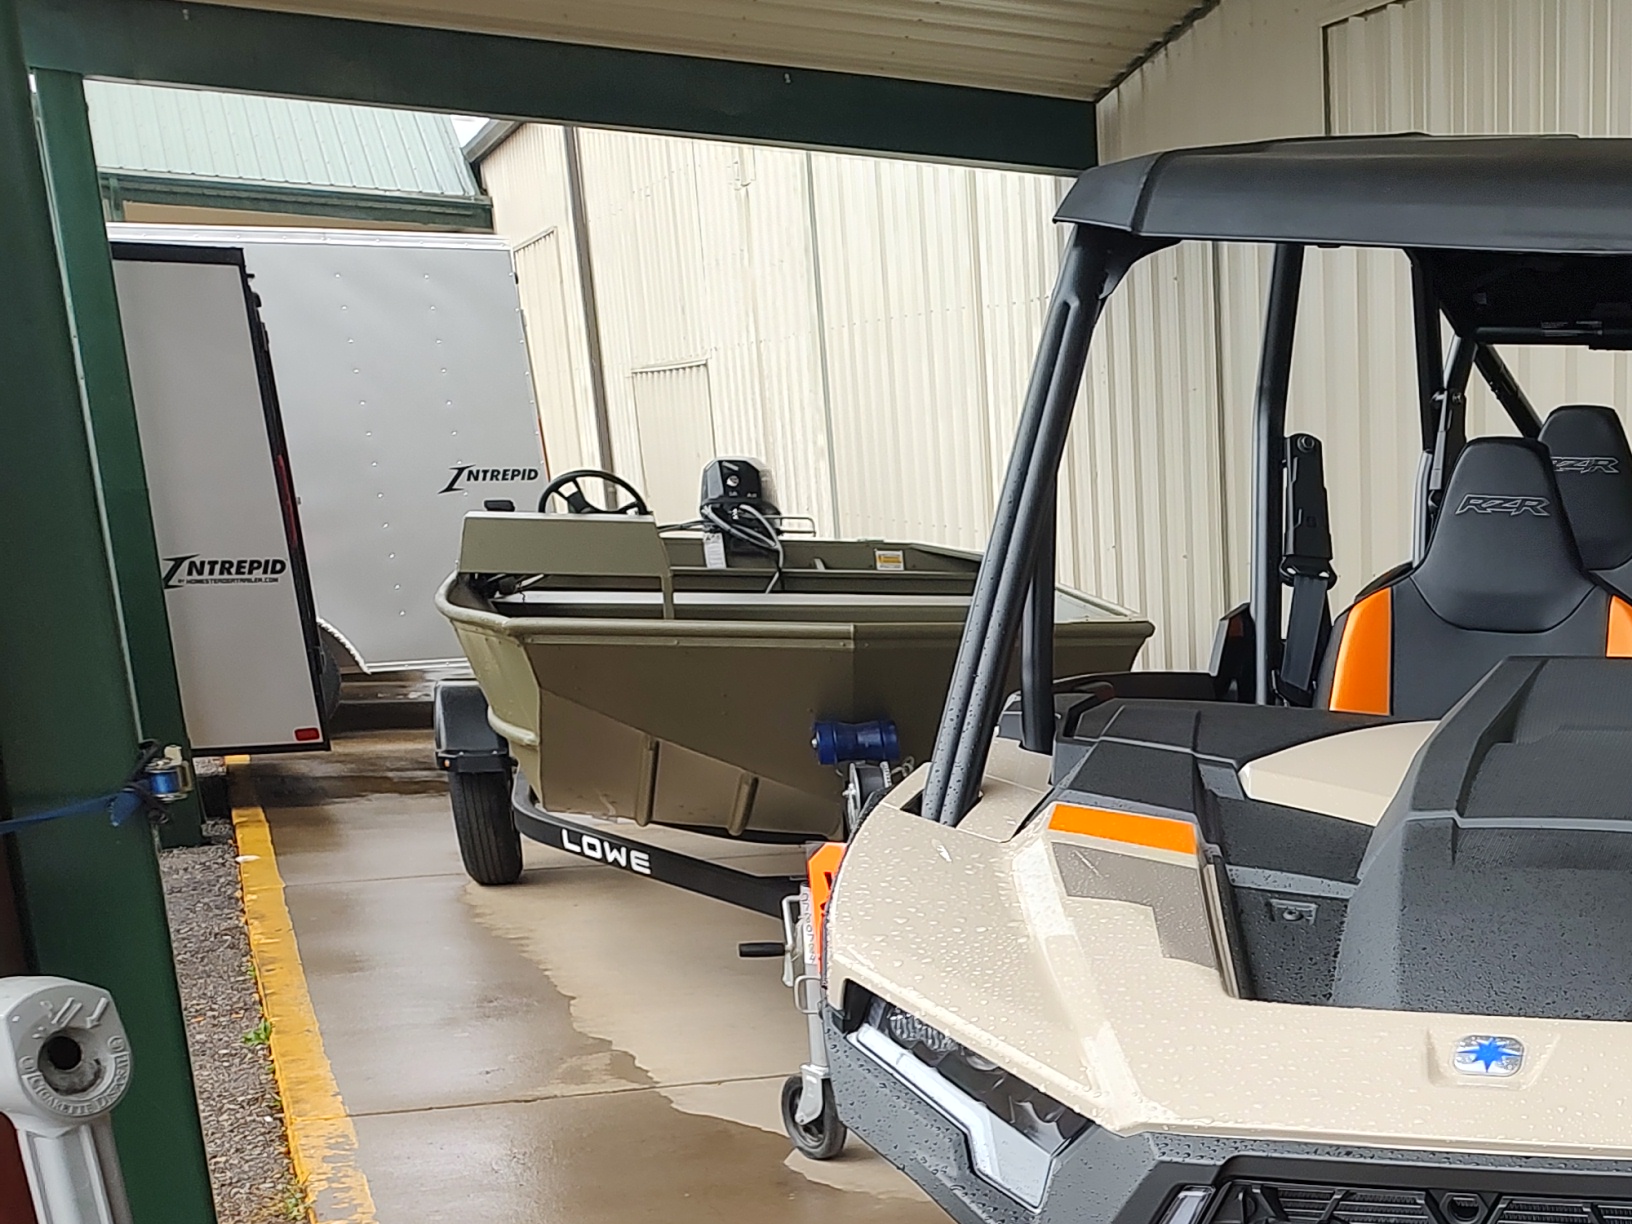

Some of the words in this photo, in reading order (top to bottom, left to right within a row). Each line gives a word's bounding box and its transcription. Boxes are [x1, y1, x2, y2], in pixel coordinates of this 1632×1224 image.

[437, 464, 539, 495] INTREPID
[1455, 494, 1550, 516] RZR
[162, 554, 287, 589] INTREPID
[562, 828, 652, 875] LOWE
